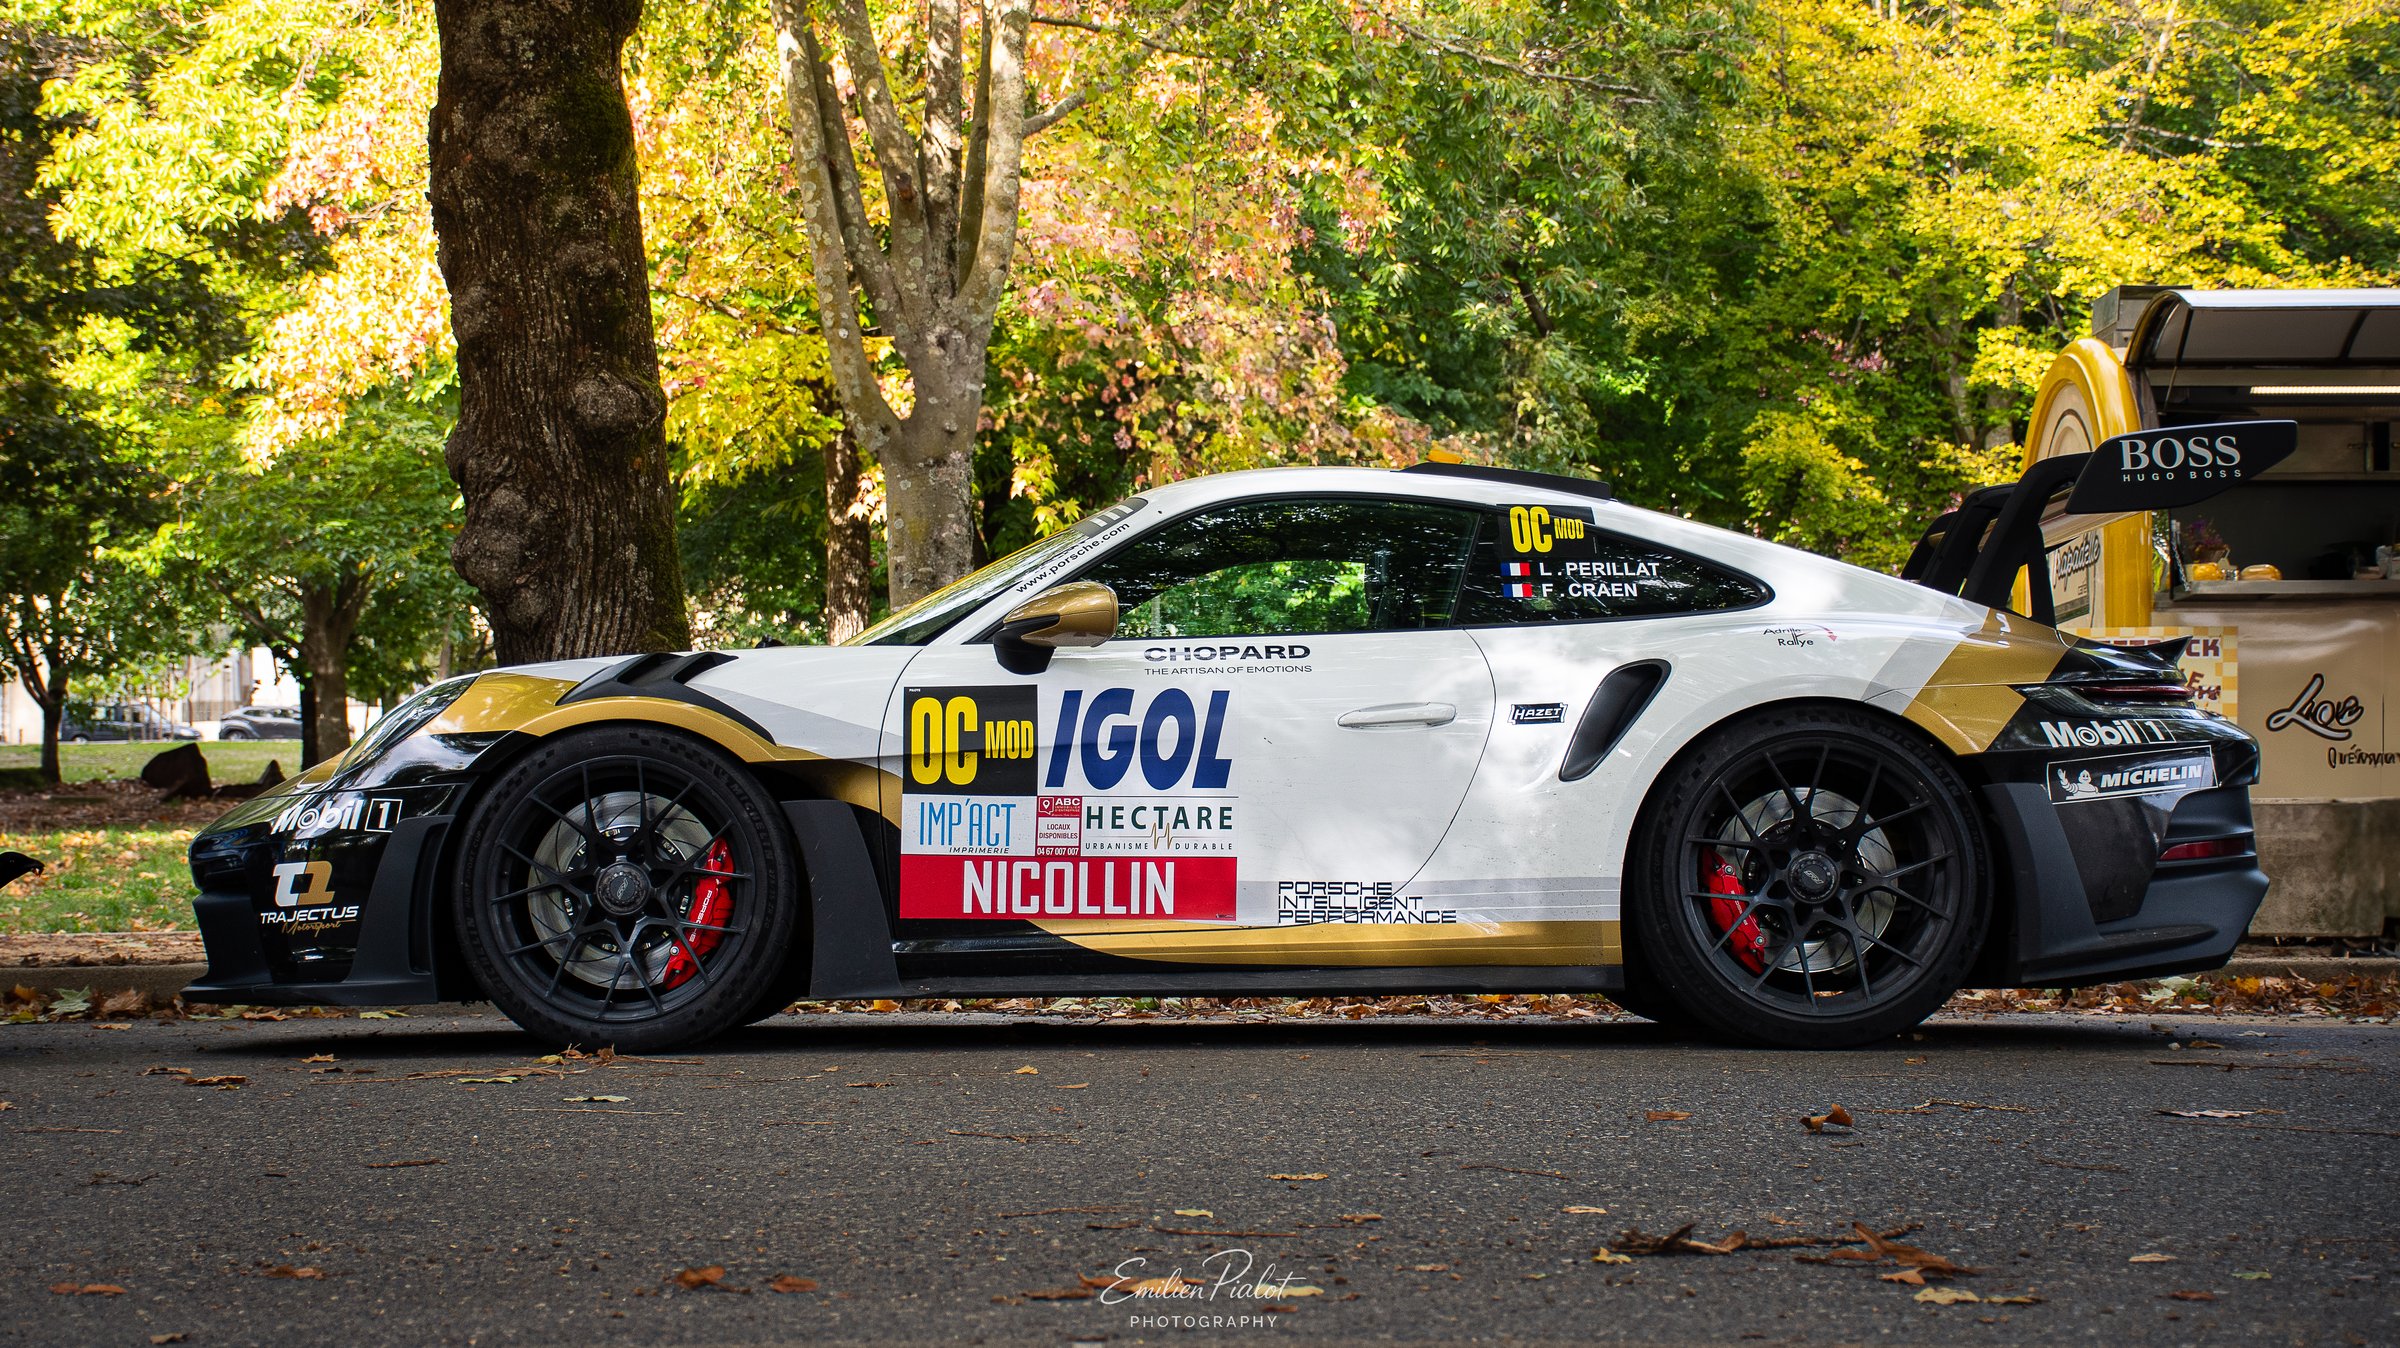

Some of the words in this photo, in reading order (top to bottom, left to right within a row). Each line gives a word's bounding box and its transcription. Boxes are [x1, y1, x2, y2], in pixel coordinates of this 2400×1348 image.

[2119, 435, 2241, 471] BOSS
[2123, 472, 2175, 482] HUGO
[2189, 469, 2242, 479] BOSS
[1509, 505, 1553, 553] OC
[1554, 517, 1585, 540] MOD
[1016, 522, 1131, 593] www.porsche.com
[1565, 562, 1660, 576] PERILLAT
[1568, 582, 1638, 597] CRAEN
[1777, 637, 1814, 648] Rallye
[1144, 645, 1311, 662] CHOPARD
[1144, 667, 1169, 676] THE
[1171, 666, 1225, 676] ARTISAN
[1227, 666, 1244, 674] OF
[1246, 665, 1313, 674] EMOTIONS
[1513, 708, 1562, 720] HAZET
[911, 696, 978, 785] OC
[985, 720, 1034, 760] MOD
[1045, 687, 1233, 790] IGOL
[2040, 719, 2143, 748] Mobil
[2144, 720, 2166, 741] 1
[2100, 764, 2203, 788] MICHELIN
[1054, 798, 1081, 806] ABC
[271, 799, 365, 835] Mobil
[378, 801, 391, 829] 1
[920, 798, 1017, 847] IMP'ACT
[1086, 805, 1233, 830] HECTARE
[1046, 823, 1071, 831] LOCAUX
[1038, 832, 1078, 840] DISPONIBLES
[1037, 847, 1046, 855] 04
[1085, 842, 1149, 850] URBANISME
[1175, 842, 1233, 850] DURABLE
[963, 860, 1175, 915] NICOLLIN
[1278, 881, 1393, 896] PORSCHE
[1278, 896, 1423, 910] INTELLIGENT
[260, 905, 360, 924] TRAJECTUS
[1278, 910, 1457, 924] PERFORMANCE
[281, 919, 358, 938] Motorsport
